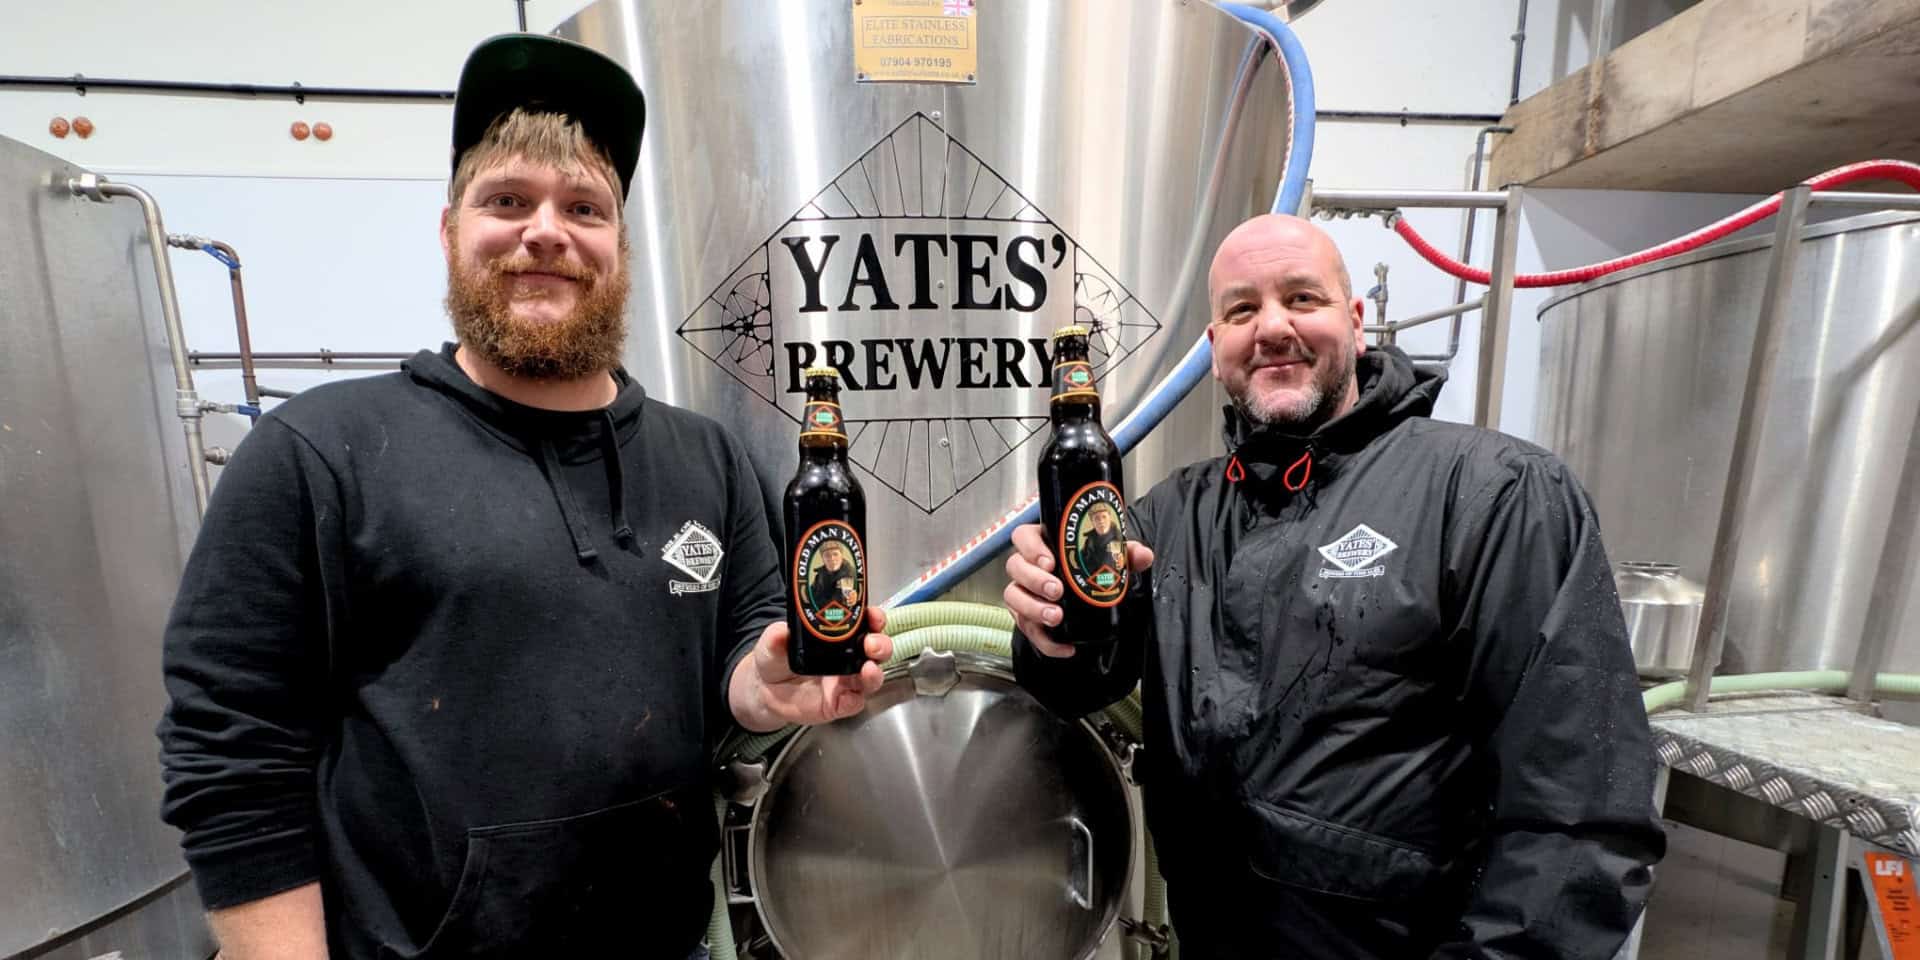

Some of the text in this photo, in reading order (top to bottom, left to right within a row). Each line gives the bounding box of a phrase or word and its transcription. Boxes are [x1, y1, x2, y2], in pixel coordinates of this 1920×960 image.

[865, 19, 967, 32] ELITE STAINLESS
[872, 34, 960, 46] FABRICATIONS
[880, 57, 952, 68] 07904 970195
[781, 232, 1067, 313] YATES'
[1065, 512, 1079, 542] OLD
[1075, 489, 1105, 512] MAN
[798, 548, 811, 577] OLD
[808, 527, 838, 547] MAN
